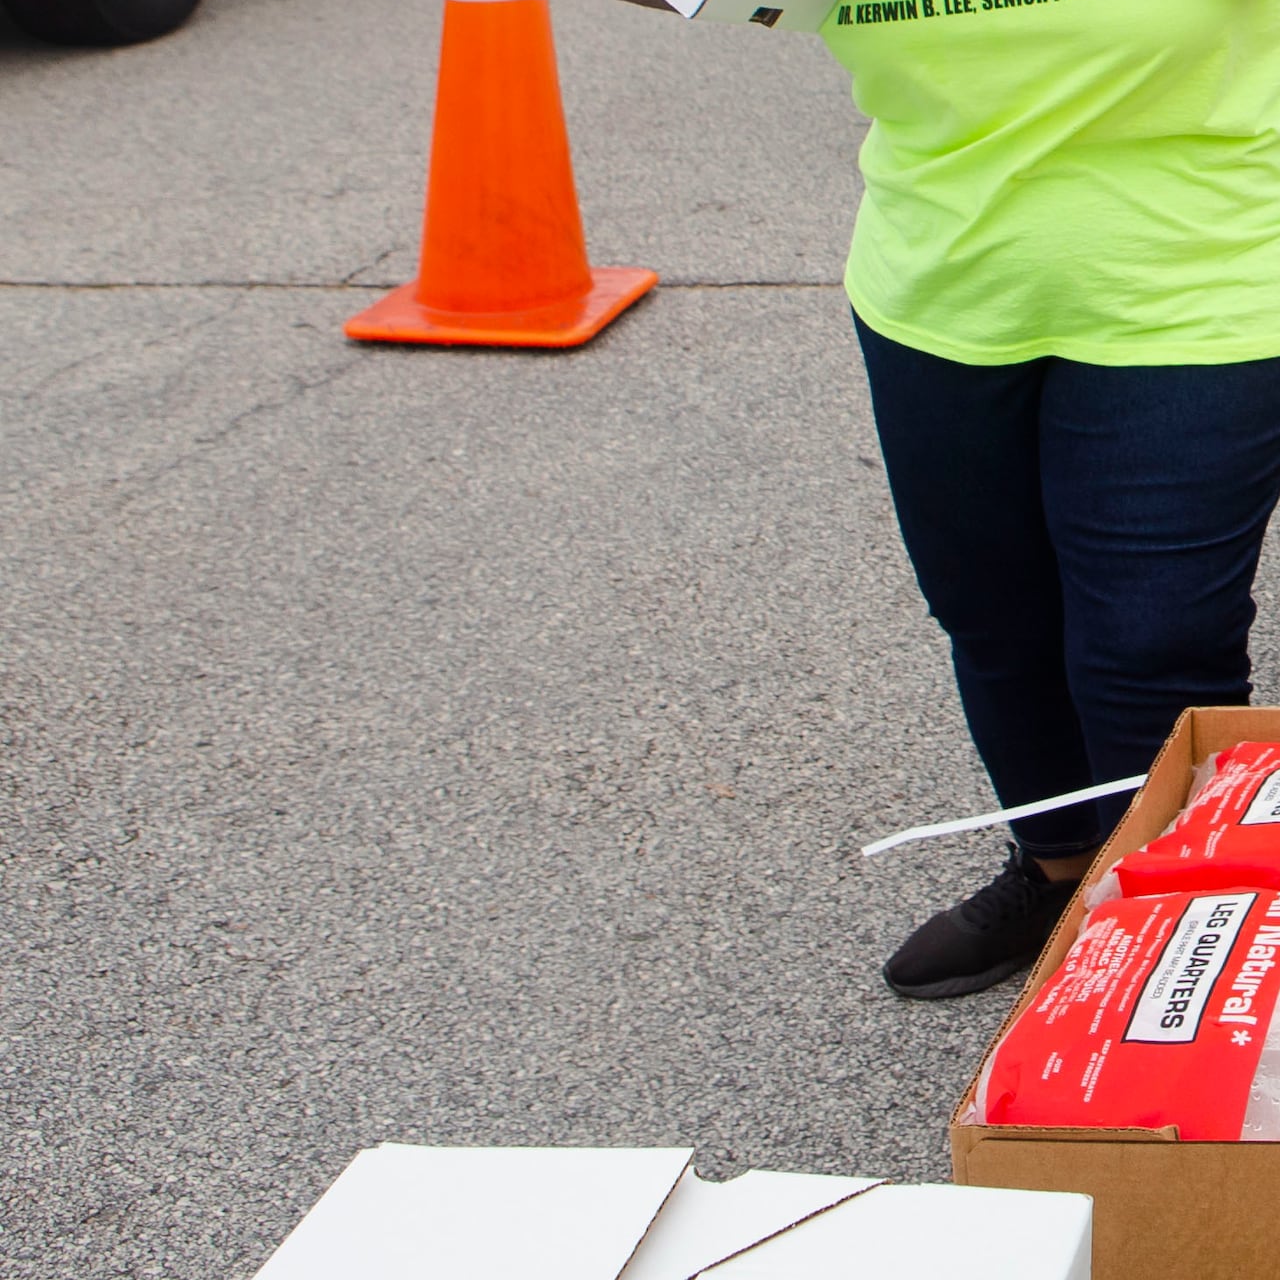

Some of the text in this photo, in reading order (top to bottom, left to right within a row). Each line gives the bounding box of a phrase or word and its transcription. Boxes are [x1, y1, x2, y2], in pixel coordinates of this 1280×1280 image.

[837, 4, 854, 26] DR.
[855, 0, 918, 25] KERWIN
[1160, 902, 1239, 1030] LEG QUARTERS
[1052, 1057, 1063, 1074] OUR
